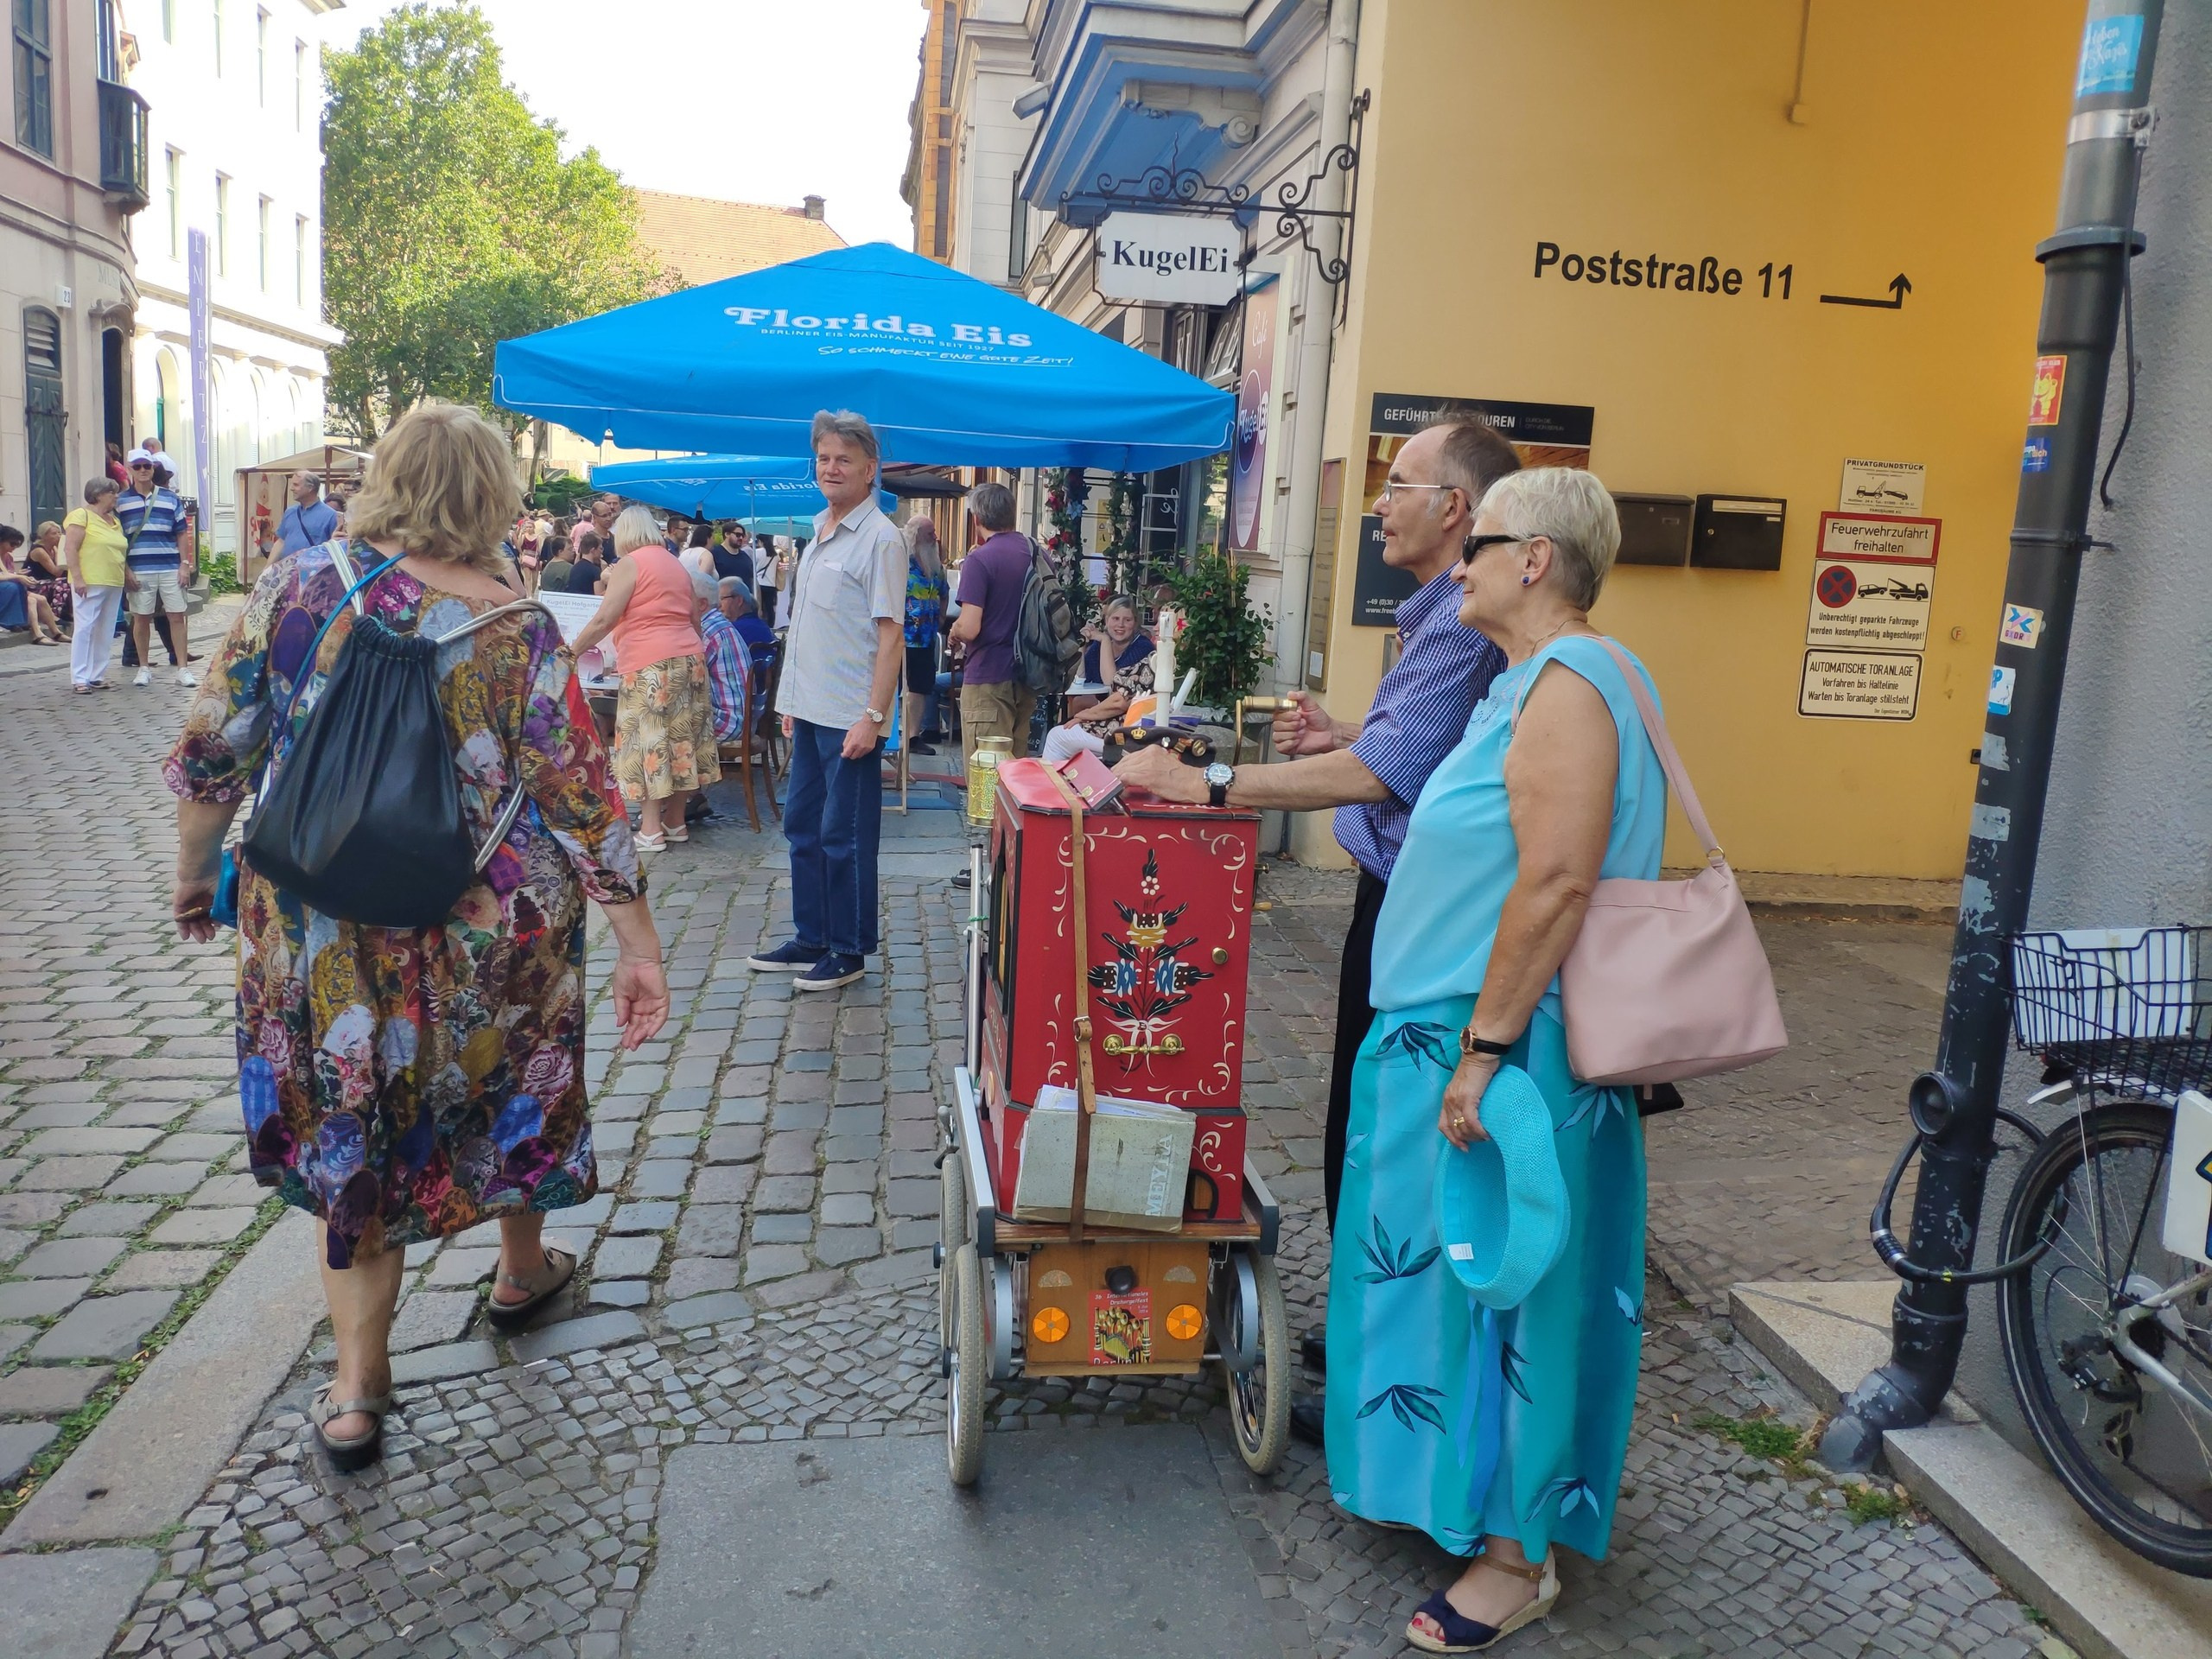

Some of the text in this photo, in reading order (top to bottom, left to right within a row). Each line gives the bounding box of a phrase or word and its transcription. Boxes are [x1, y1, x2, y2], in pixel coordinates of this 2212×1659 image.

[1111, 239, 1229, 276] KugelEi
[1534, 241, 1793, 300] Poststraße 11
[63, 290, 71, 303] 23
[723, 306, 1033, 347] Florida Eis
[760, 328, 995, 353] BERLINER EIS-MANUFAKTUR SEIT 1927
[1383, 407, 1440, 423] GEFÜHRT
[1831, 522, 1929, 540] Feuerwehrzufahrt
[1853, 539, 1904, 553] freihalten
[1365, 607, 1396, 615] www.freeb
[1819, 612, 1919, 628] Unberechtigt geparkte Fahrzeuge
[1810, 626, 1925, 641] werden kostenpflichtig abgeschleppt!
[1809, 661, 1914, 677] AUTOMATISCHE TORANLAGE
[1822, 677, 1899, 690] Vorfahren bis Haltelinie
[1808, 691, 1910, 705] Warten bis Toranlage stillsteht
